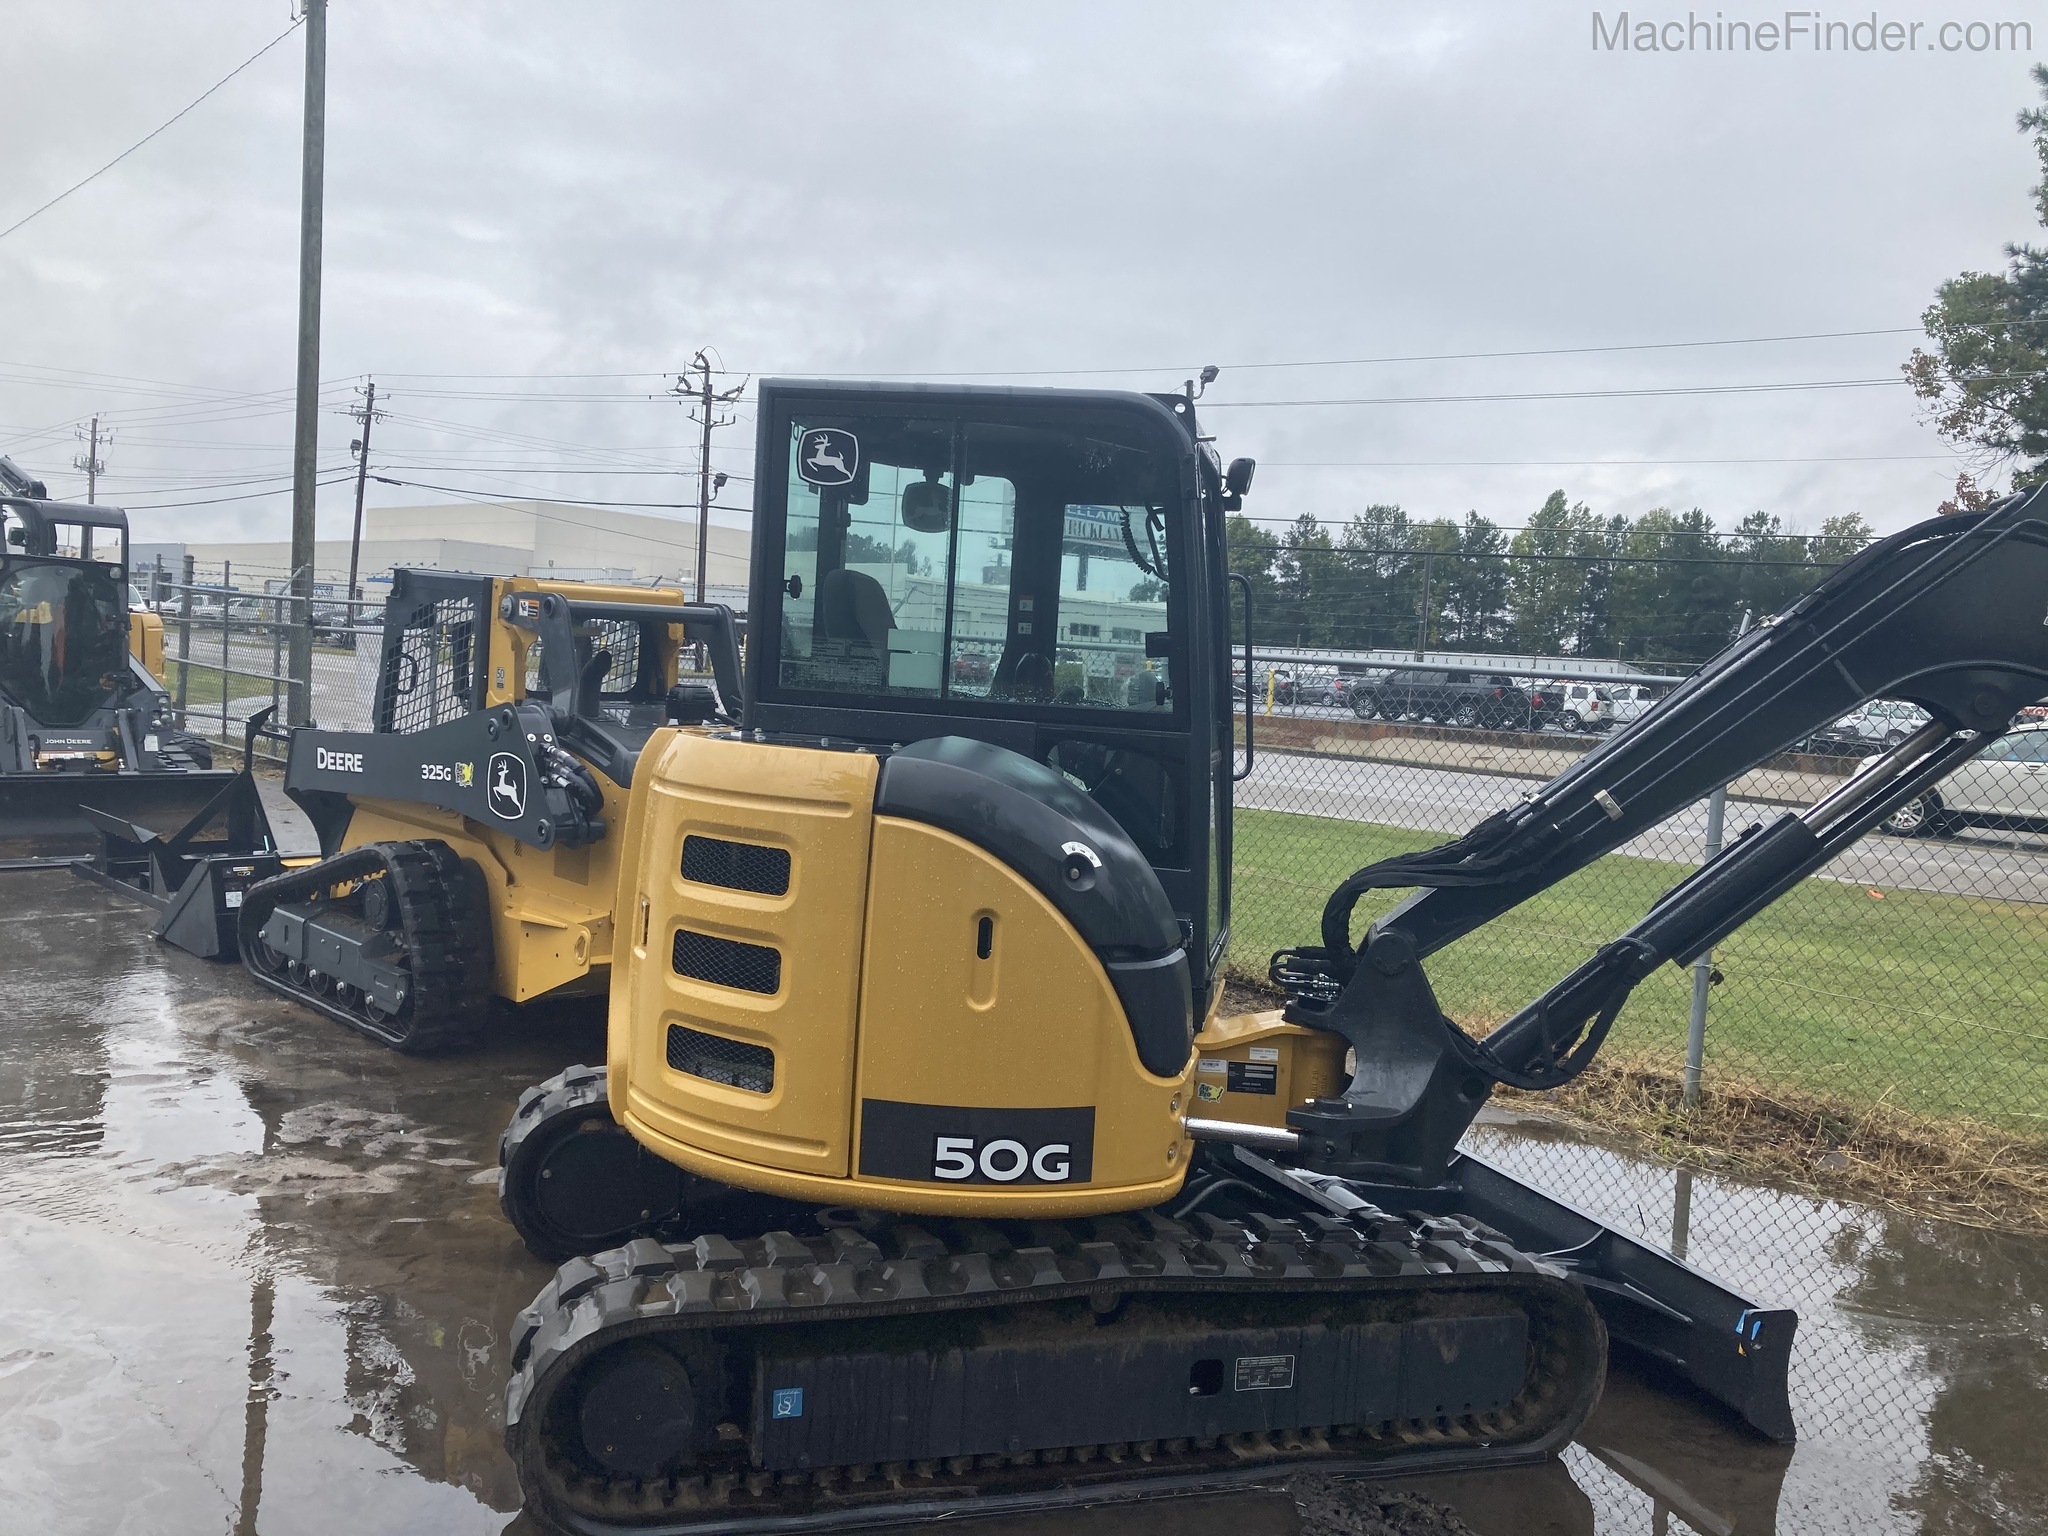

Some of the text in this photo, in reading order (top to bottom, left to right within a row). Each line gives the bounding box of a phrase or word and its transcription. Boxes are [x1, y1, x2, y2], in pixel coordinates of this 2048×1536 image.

[1066, 504, 1126, 523] ELLAM
[1065, 518, 1124, 542] RICKLAN
[316, 747, 363, 773] DEERE
[421, 764, 451, 781] 325G
[934, 1136, 1070, 1181] 50G
